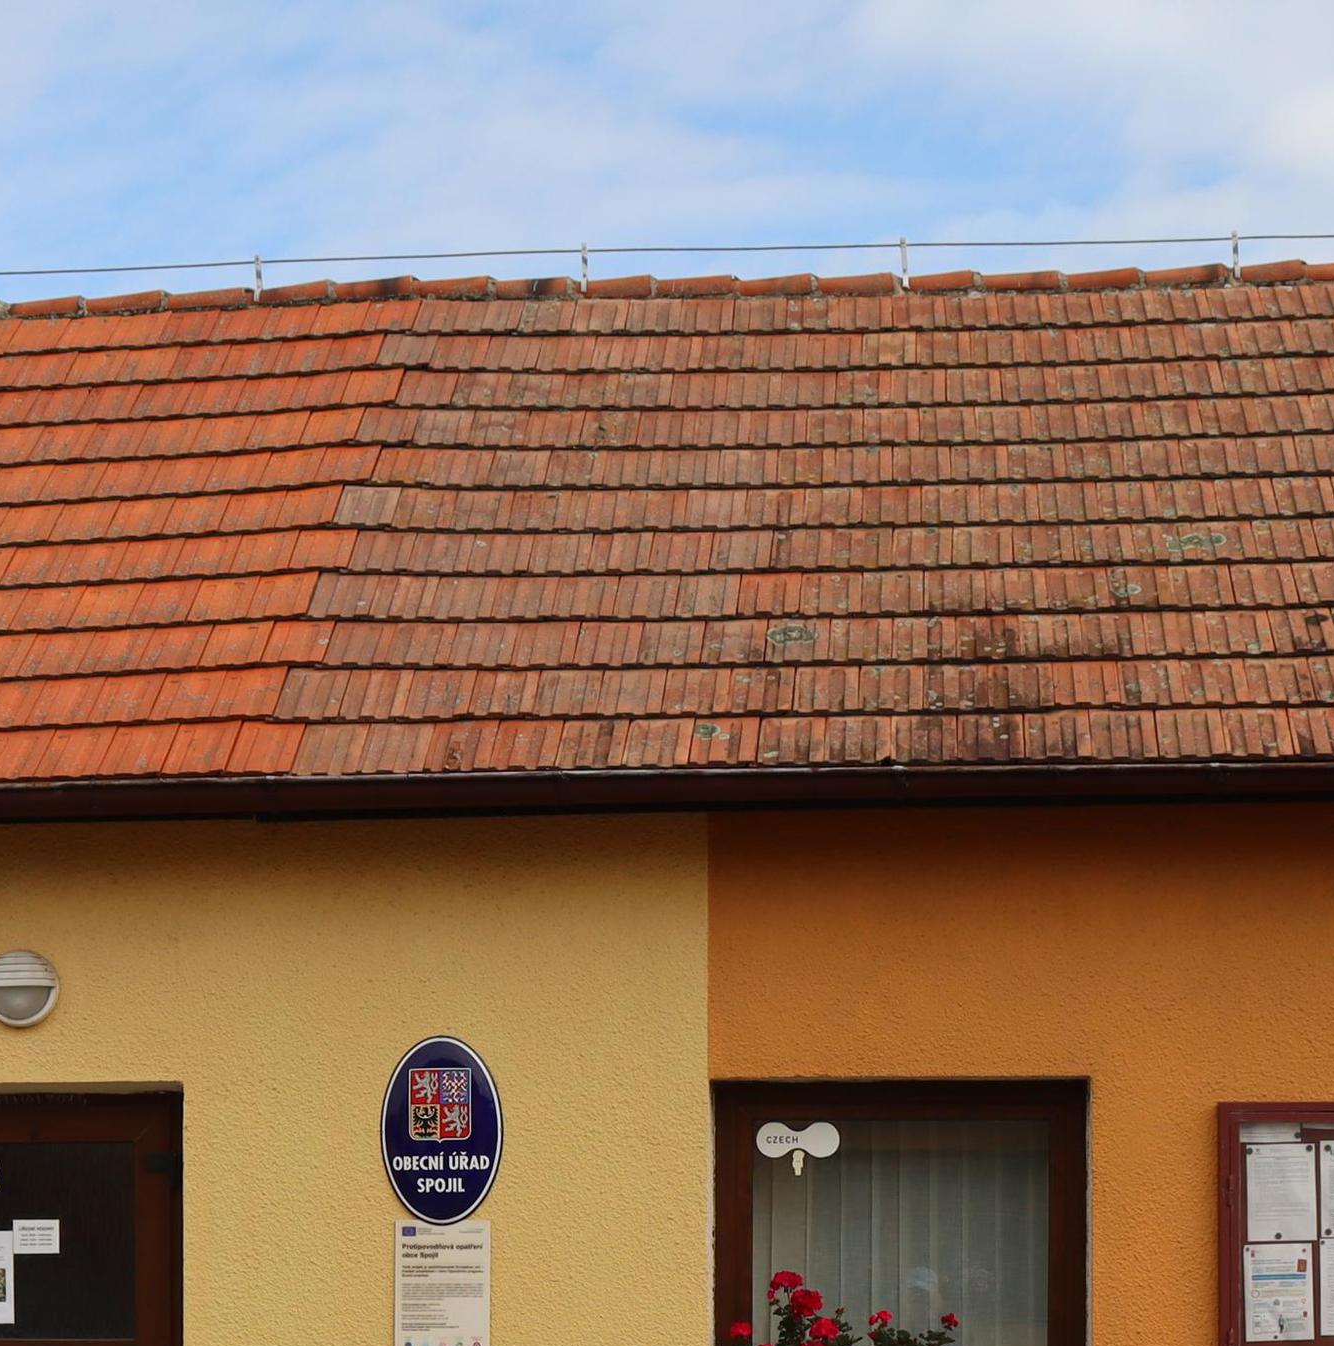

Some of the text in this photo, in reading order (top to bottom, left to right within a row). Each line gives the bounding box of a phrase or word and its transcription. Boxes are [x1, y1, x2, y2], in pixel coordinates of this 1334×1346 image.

[766, 1135, 799, 1144] CZECH
[392, 1151, 490, 1171] OBECNÍ ÚŘAD
[417, 1178, 465, 1193] SPOJIL
